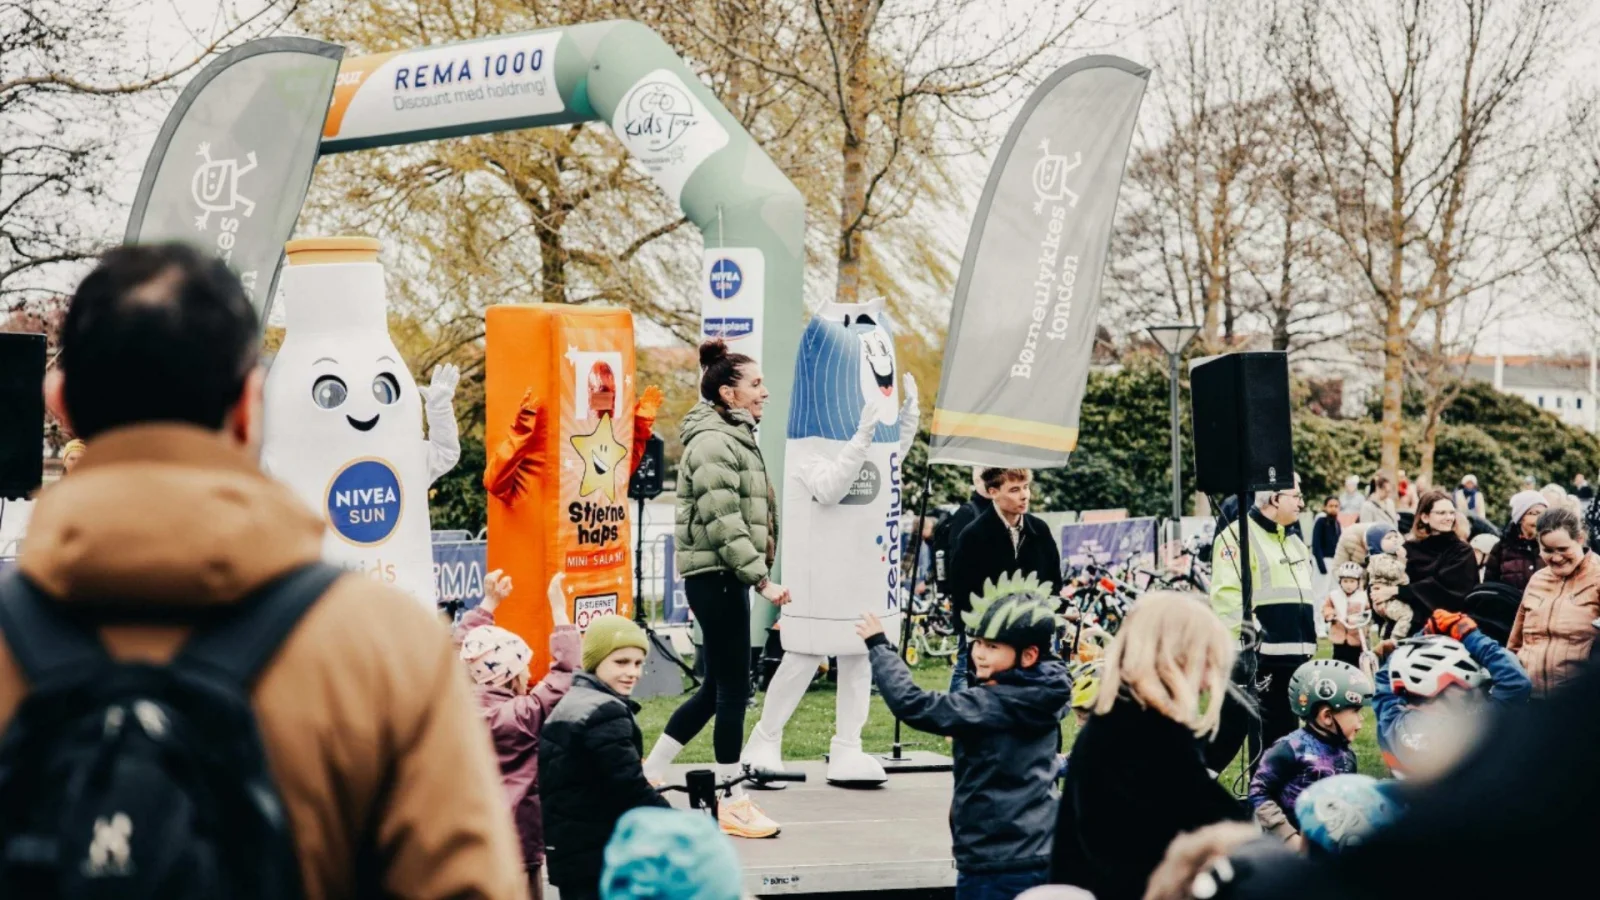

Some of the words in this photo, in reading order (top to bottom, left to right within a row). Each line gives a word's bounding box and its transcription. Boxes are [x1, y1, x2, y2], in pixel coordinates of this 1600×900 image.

[395, 60, 471, 90] REMA
[484, 49, 543, 78] 1000
[392, 93, 451, 111] Discount
[454, 87, 484, 101] med
[487, 77, 547, 99] holdning!
[711, 271, 740, 281] NIVEA
[1010, 205, 1067, 379] Børneulykkes
[1046, 255, 1079, 341] fonden
[335, 486, 397, 507] NIVEA
[349, 507, 385, 524] SUN
[568, 502, 625, 528] Stjerne
[578, 524, 618, 546] haps
[885, 452, 901, 609] zendium
[567, 556, 588, 568] MINI
[593, 552, 624, 566] SALAMI
